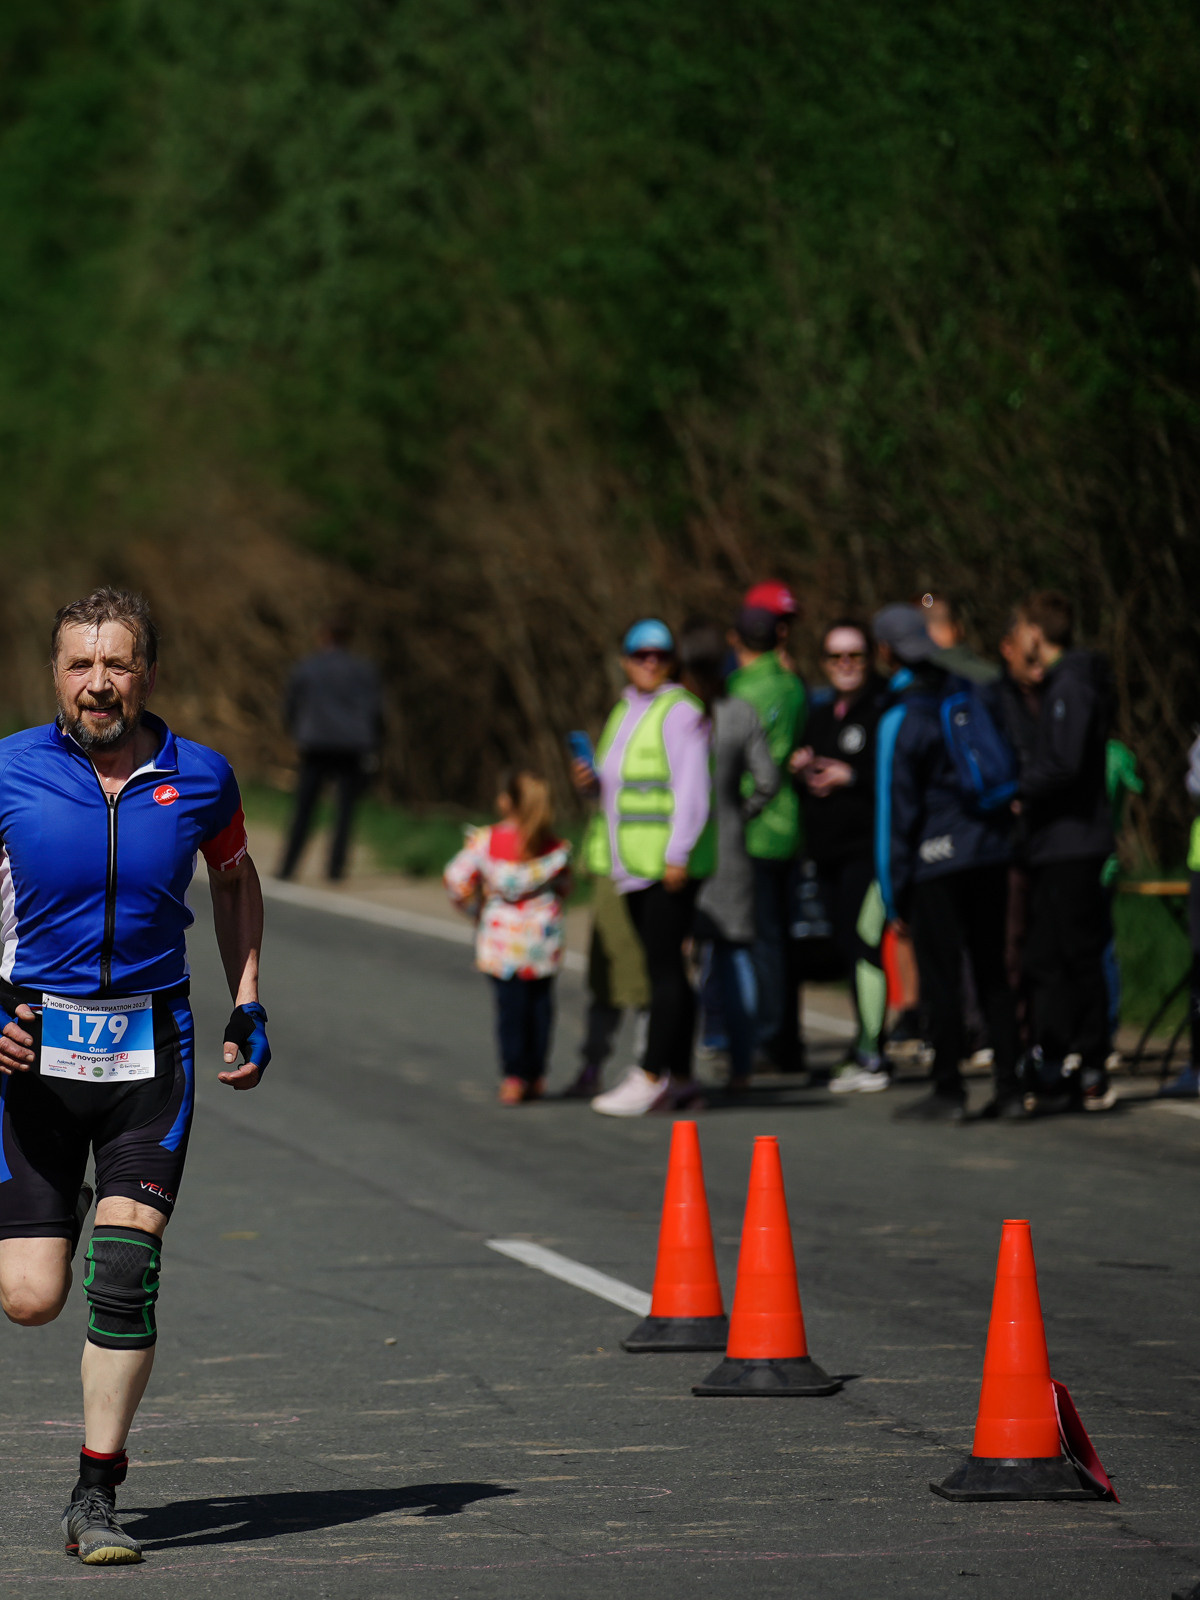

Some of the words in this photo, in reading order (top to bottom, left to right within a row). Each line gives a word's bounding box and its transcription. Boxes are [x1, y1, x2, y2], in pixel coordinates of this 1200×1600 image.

[50, 1002, 101, 1012] НОВГОРОДСКИЙ
[101, 1003, 132, 1012] ТРИАТЛОН
[132, 1001, 146, 1010] 2023
[67, 1013, 129, 1045] 179
[140, 1180, 176, 1204] VELO
